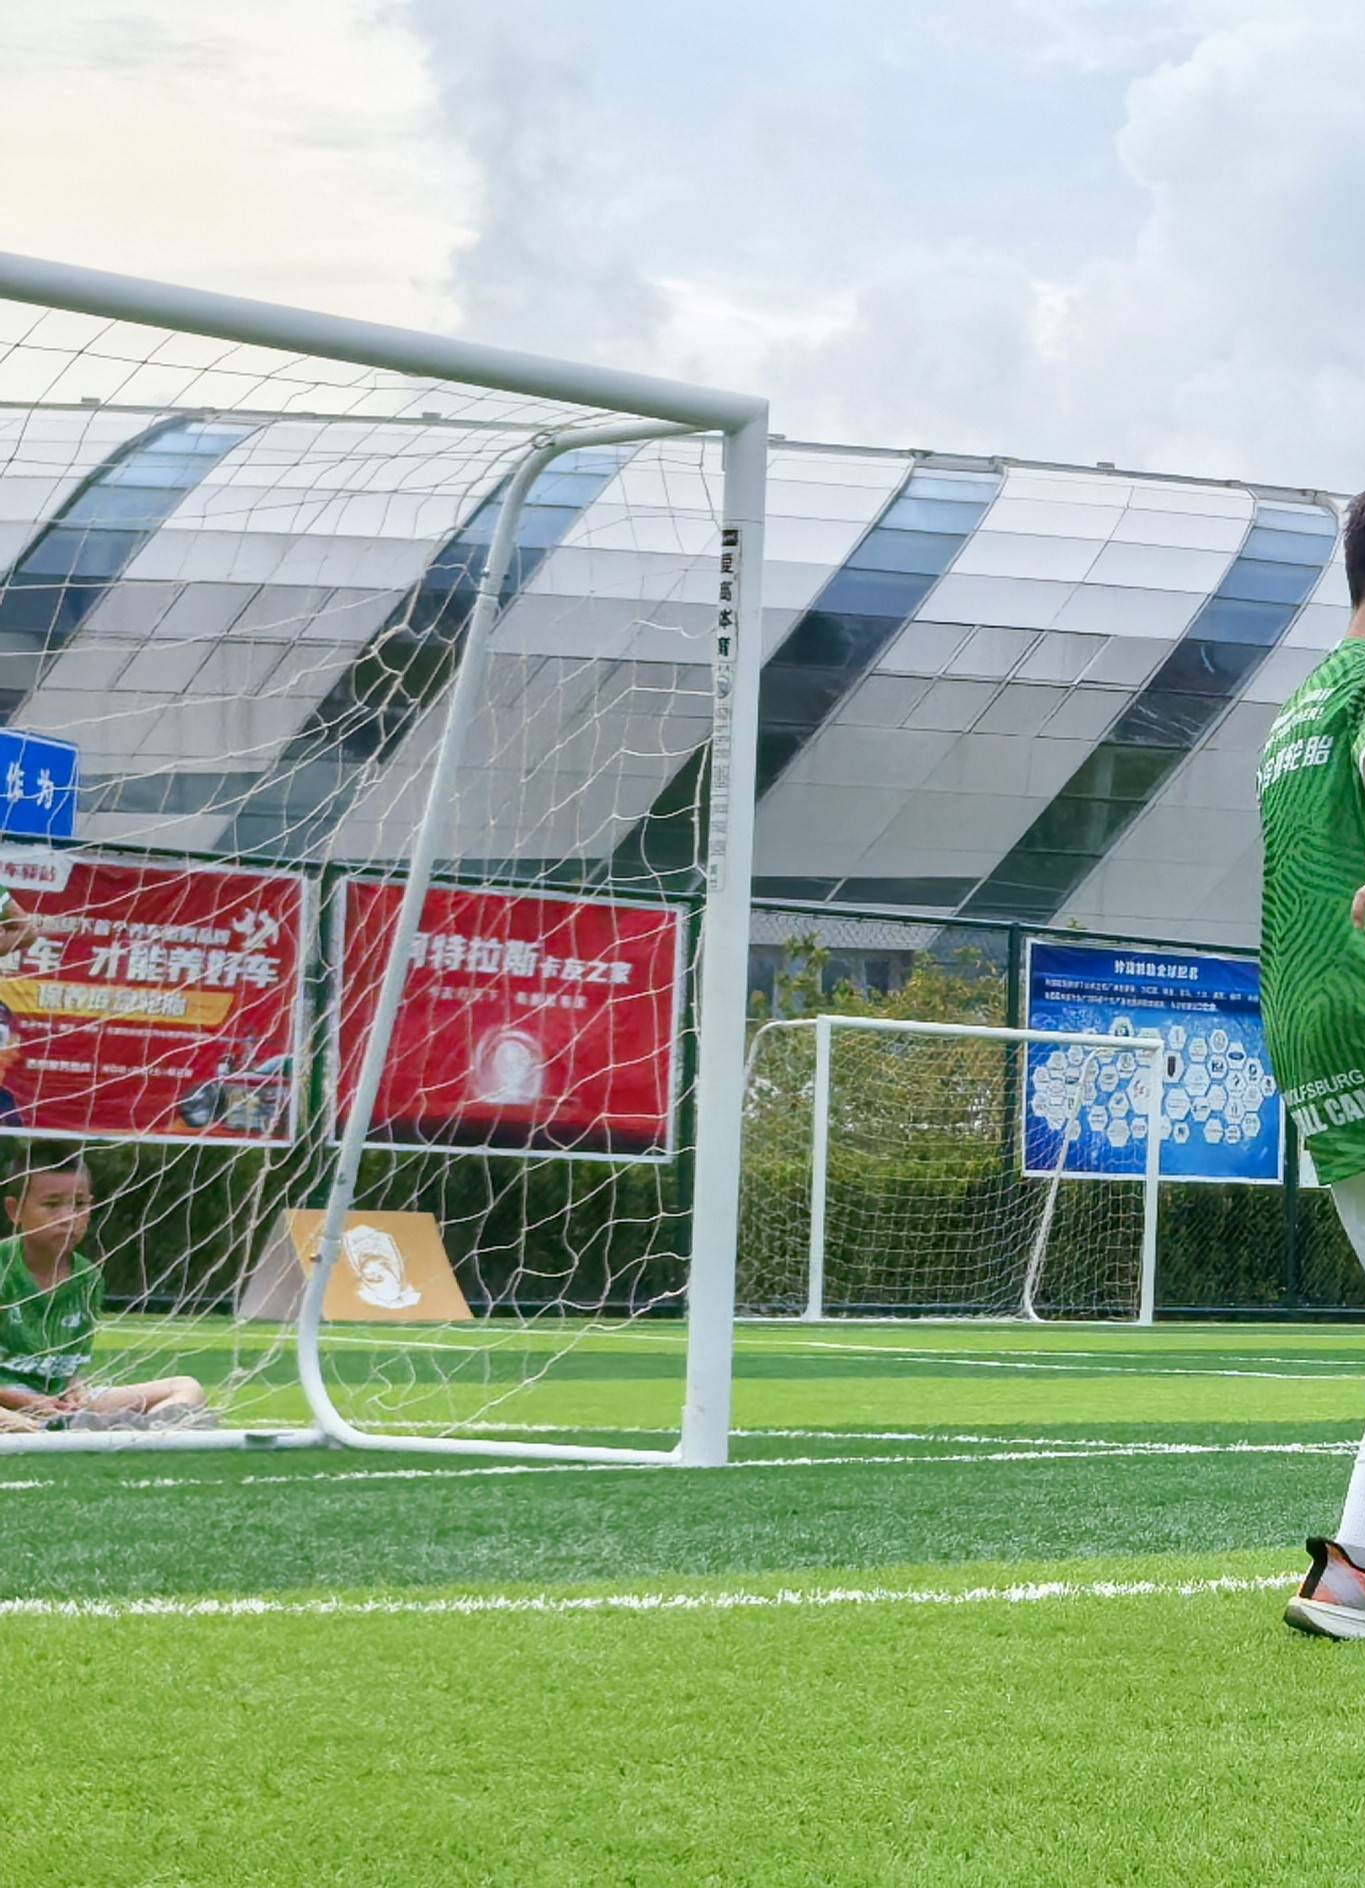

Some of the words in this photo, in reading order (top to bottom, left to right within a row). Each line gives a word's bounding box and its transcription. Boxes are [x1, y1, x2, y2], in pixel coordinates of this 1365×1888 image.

[89, 942, 280, 988] 才能养好车
